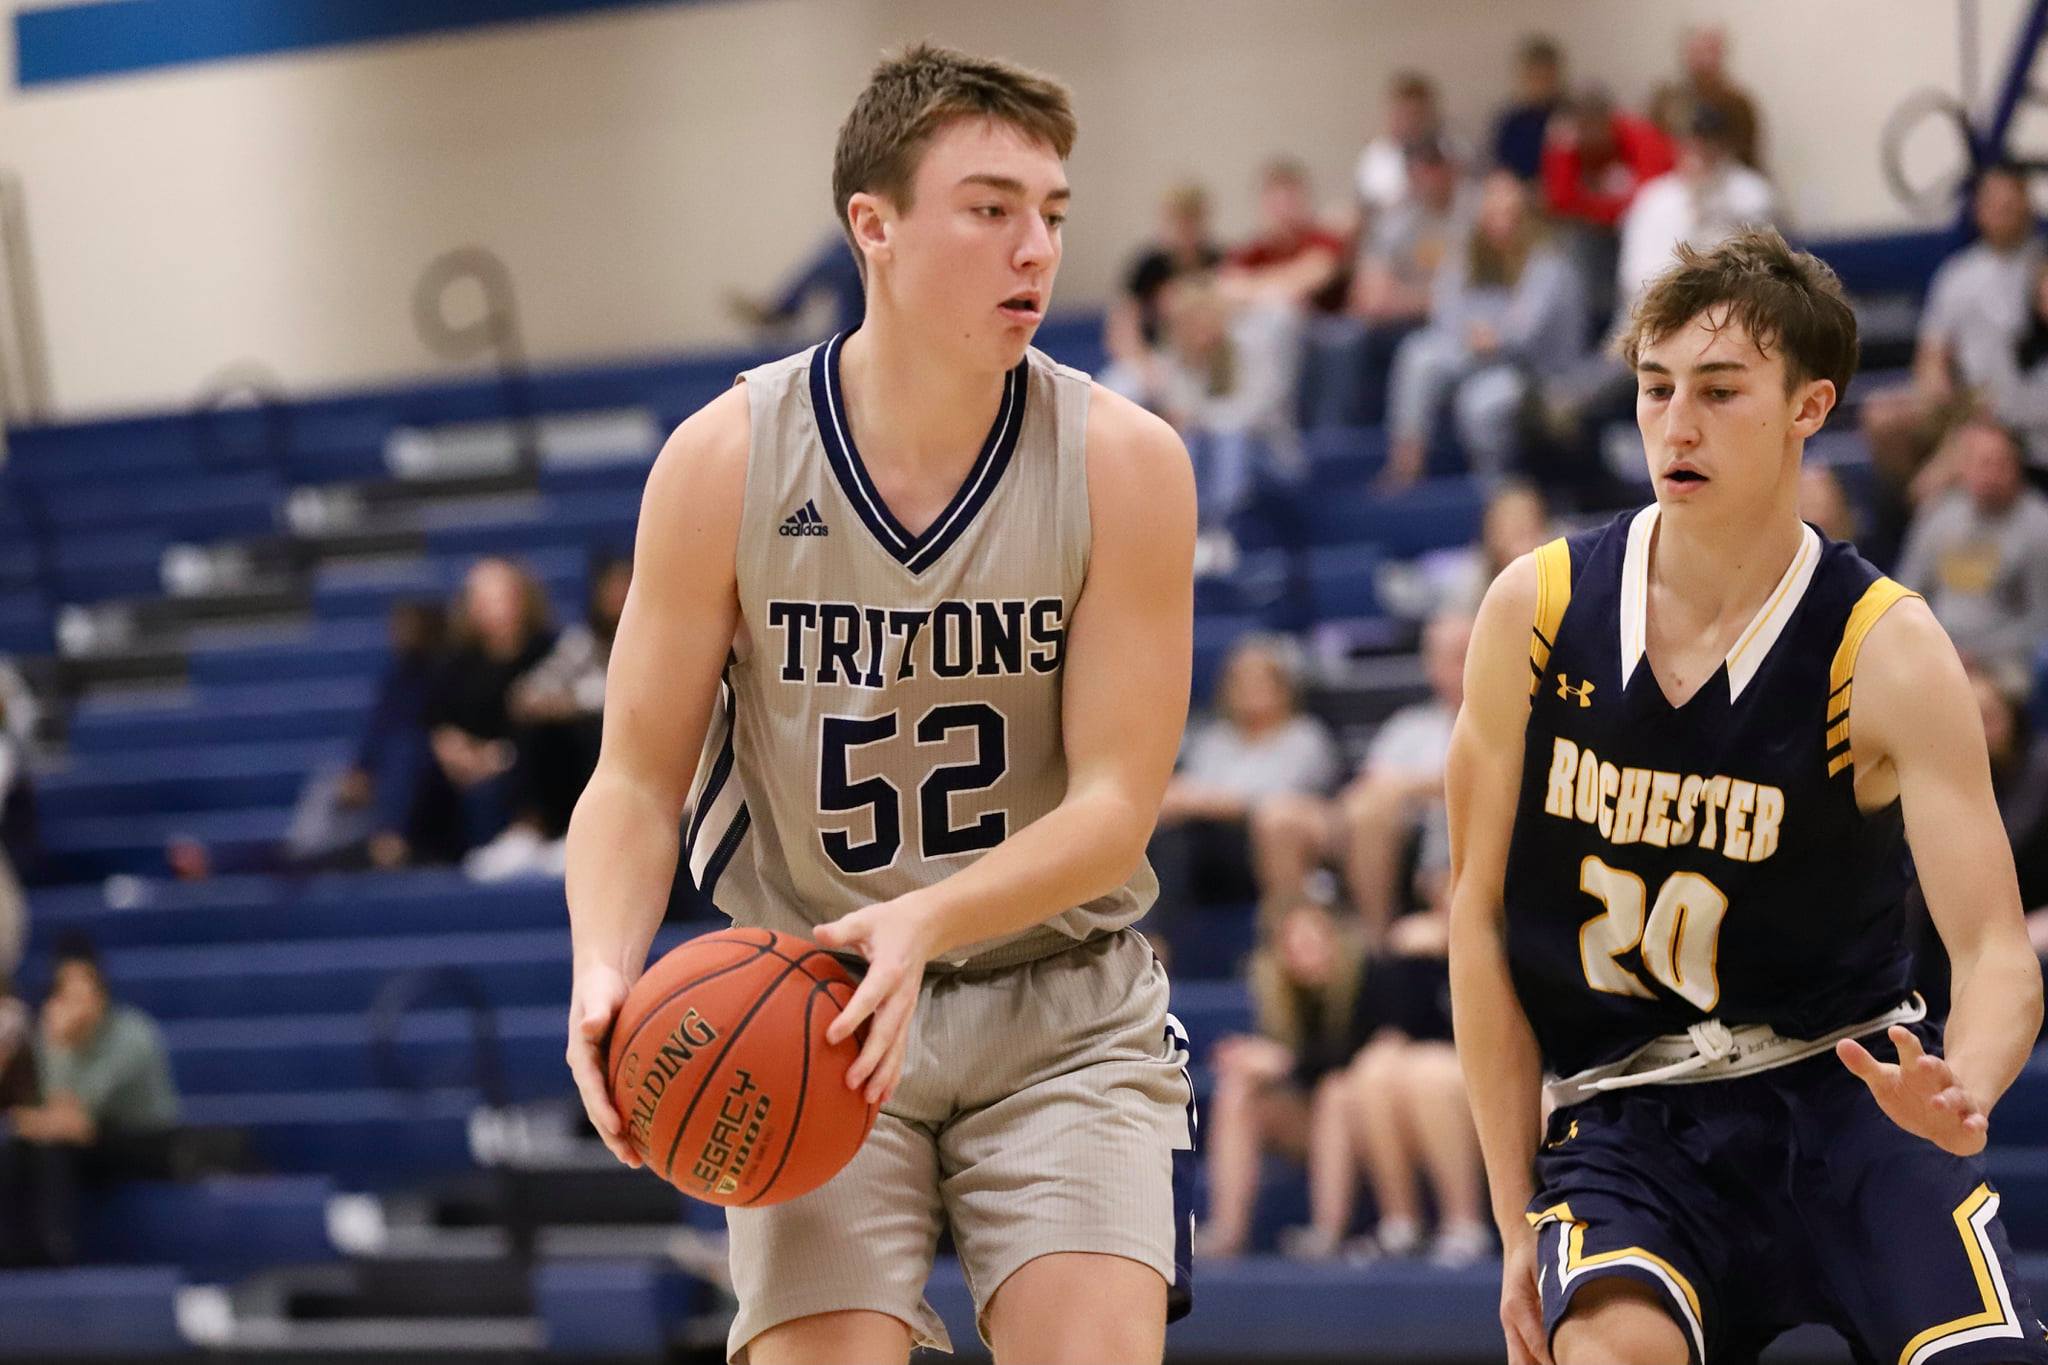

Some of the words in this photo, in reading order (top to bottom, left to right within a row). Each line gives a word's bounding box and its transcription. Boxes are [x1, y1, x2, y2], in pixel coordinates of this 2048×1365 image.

[778, 522, 829, 537] adidas
[767, 597, 1064, 689] TRITONS
[818, 701, 1008, 875] 52
[1545, 736, 1785, 863] ROCHESTER
[1579, 854, 1728, 1013] 20
[627, 1007, 718, 1155] PALDING
